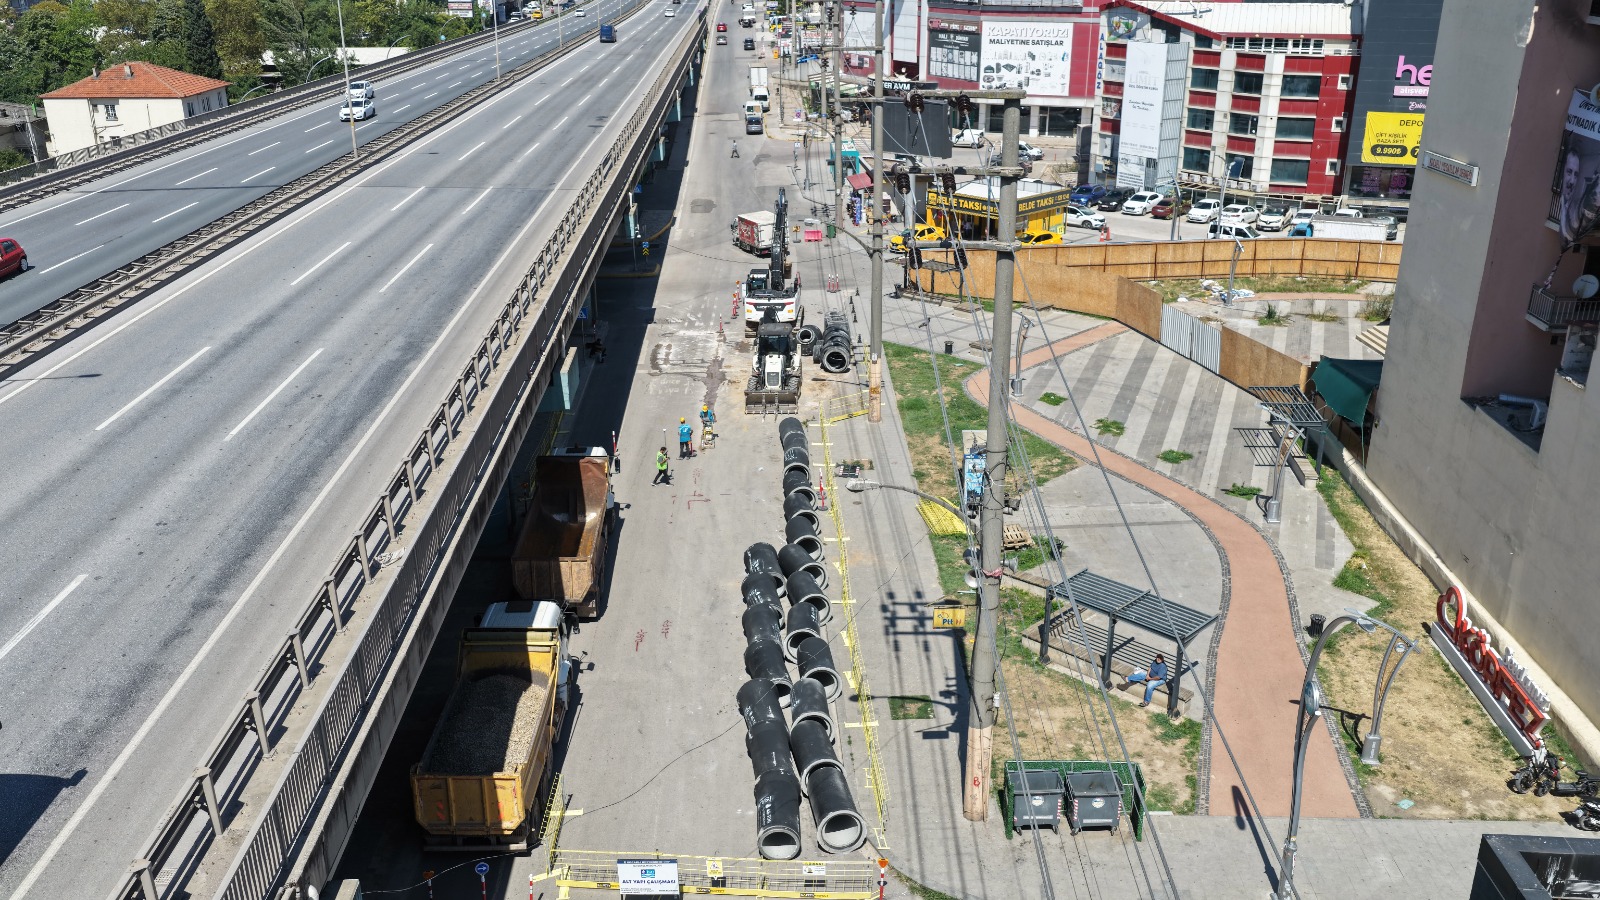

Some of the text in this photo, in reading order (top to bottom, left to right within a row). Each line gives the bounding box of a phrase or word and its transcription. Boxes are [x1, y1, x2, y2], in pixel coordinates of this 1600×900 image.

[1031, 39, 1064, 48] SATIŞLAR
[1096, 33, 1105, 89] ALAGÖZ
[893, 82, 911, 91] AVM
[1399, 119, 1424, 127] DEPO
[958, 199, 983, 211] TAKSİ
[1018, 200, 1036, 212] BELDE
[1036, 197, 1055, 208] TAKSİ
[1457, 618, 1545, 748] KÖRFEZ
